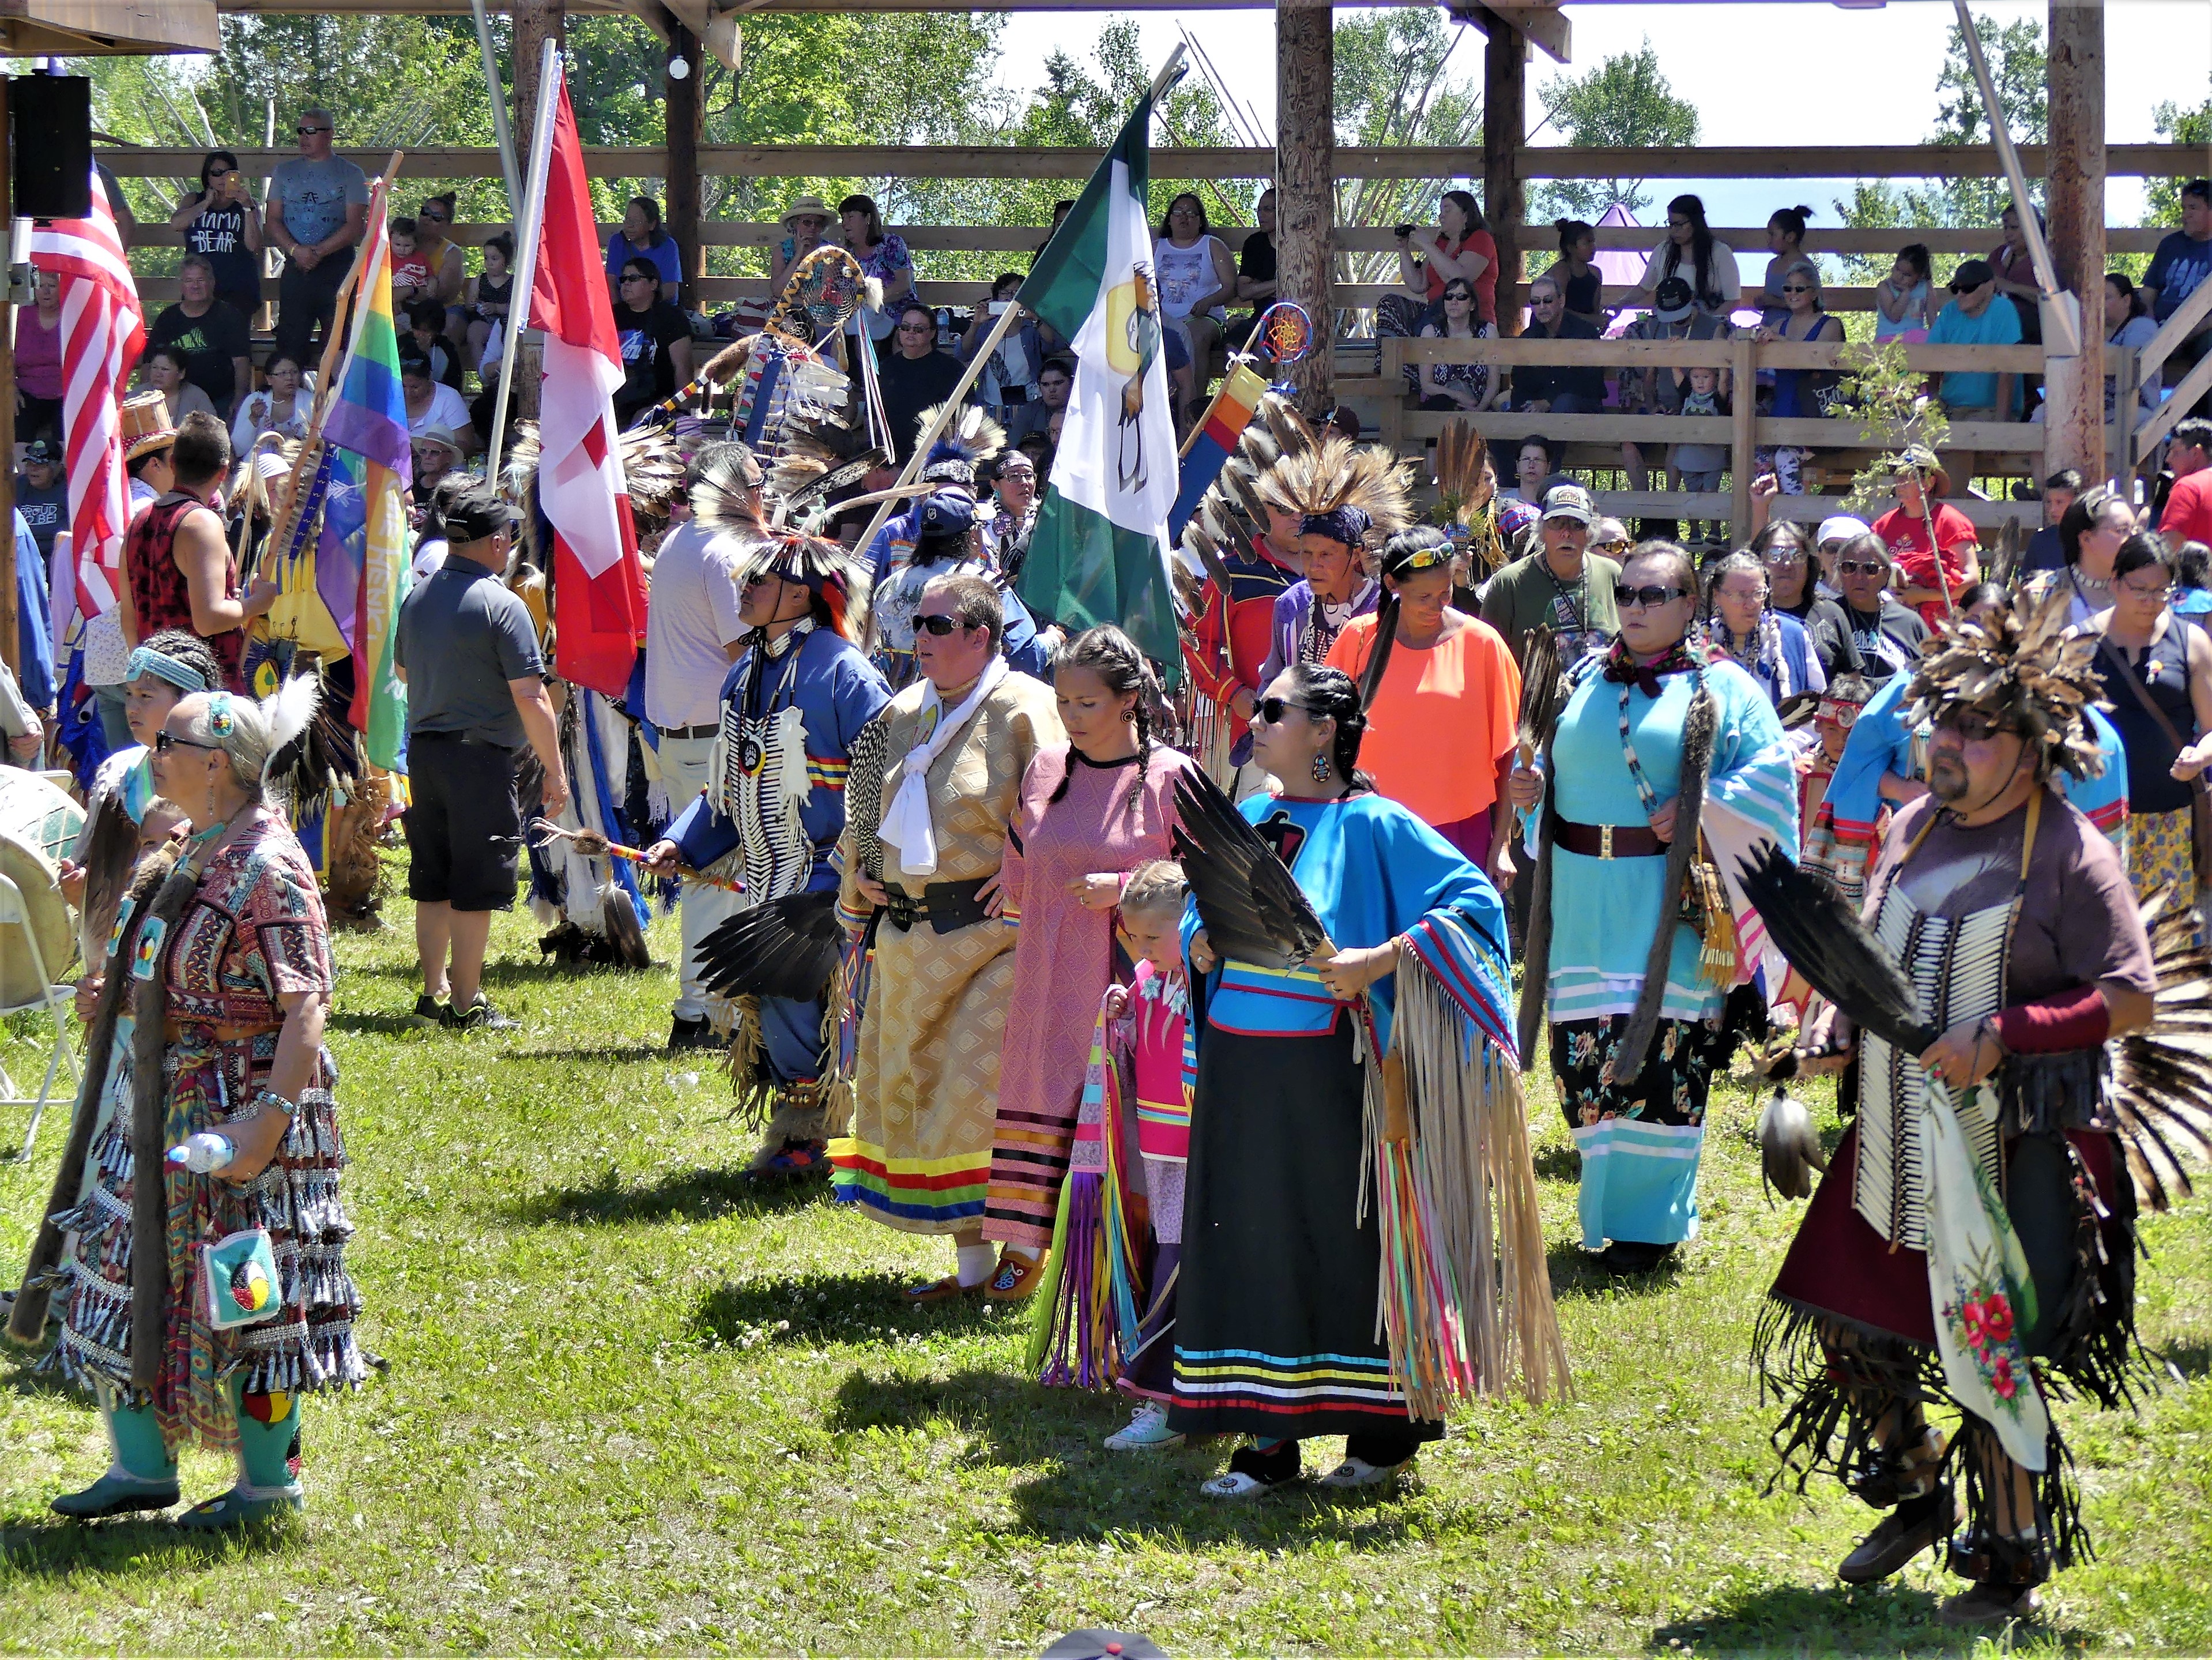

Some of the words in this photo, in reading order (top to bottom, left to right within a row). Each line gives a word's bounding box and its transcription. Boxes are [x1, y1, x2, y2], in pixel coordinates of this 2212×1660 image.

[197, 230, 233, 253] BEAR
[20, 505, 58, 516] PROUD
[39, 513, 56, 524] BE!
